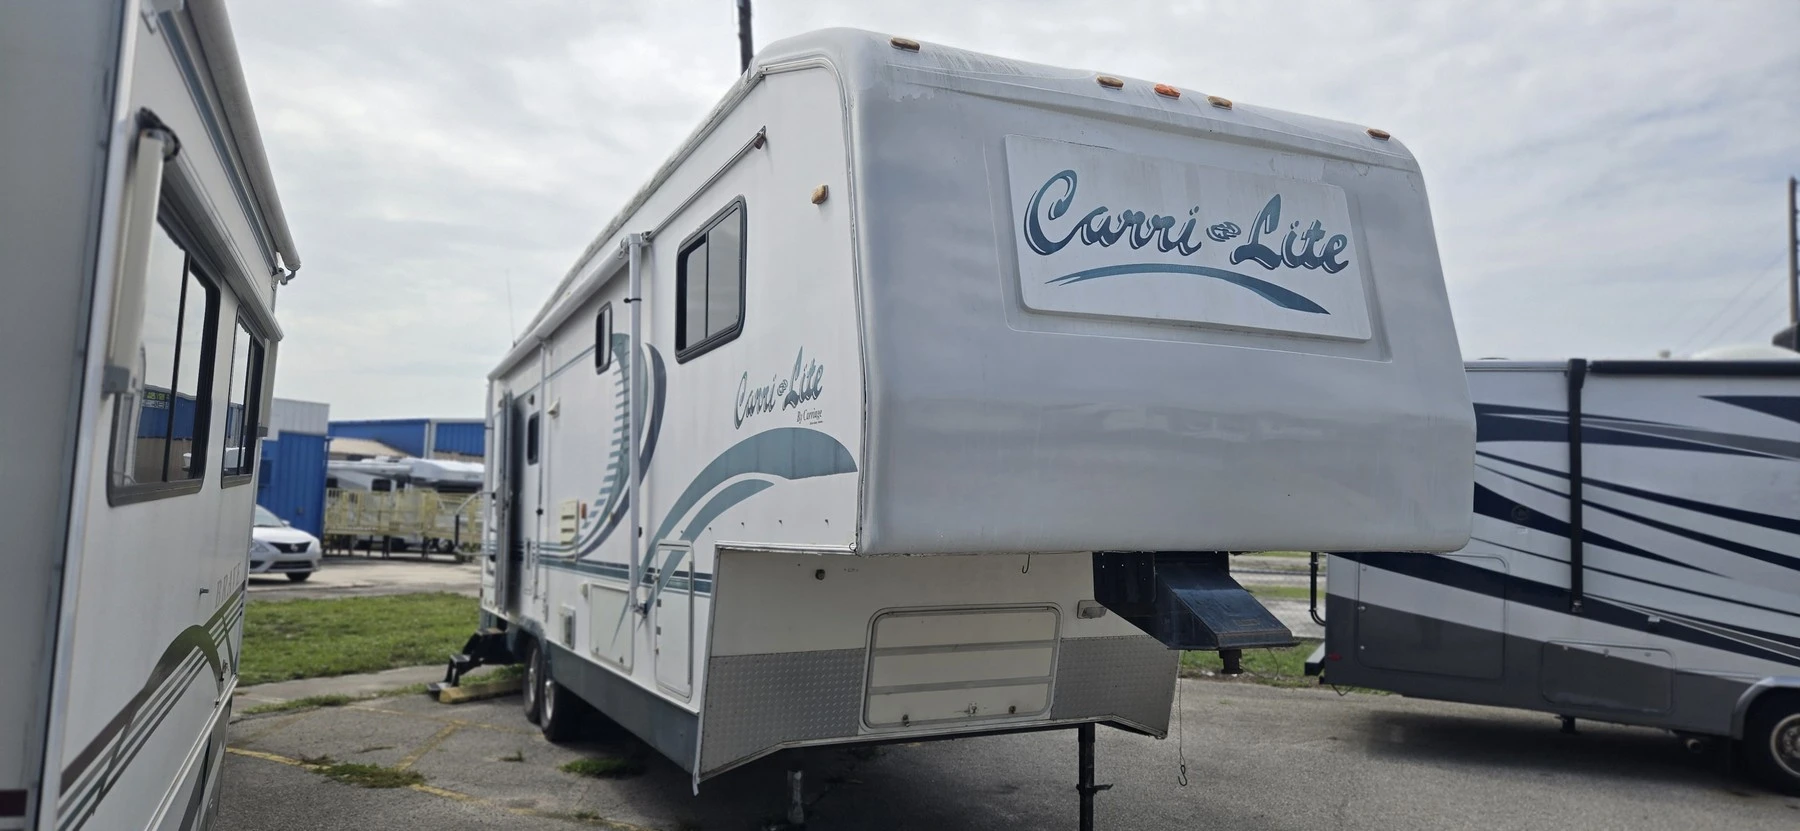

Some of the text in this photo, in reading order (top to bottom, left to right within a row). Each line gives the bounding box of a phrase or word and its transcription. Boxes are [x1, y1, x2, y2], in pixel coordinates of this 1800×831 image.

[1023, 169, 1349, 274] Carri Lite
[734, 345, 824, 430] Carri Lite
